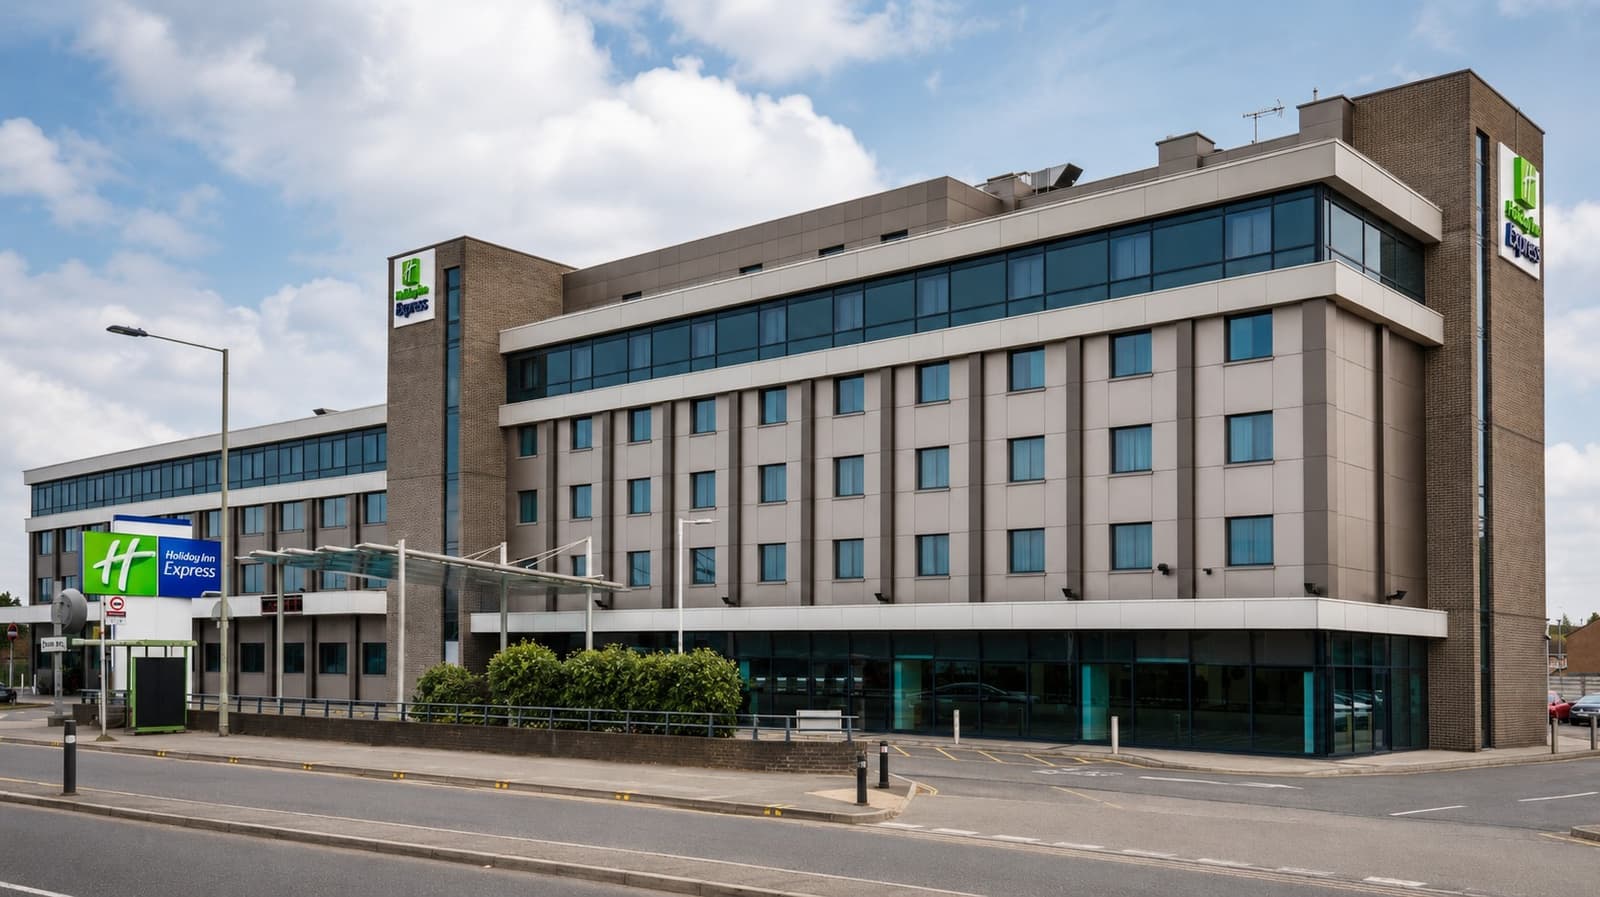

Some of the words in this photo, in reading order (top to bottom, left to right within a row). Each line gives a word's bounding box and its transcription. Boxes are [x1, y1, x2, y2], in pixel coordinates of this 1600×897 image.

[1505, 222, 1540, 264] Express
[396, 299, 429, 318] Express
[166, 551, 200, 564] Holiday
[201, 553, 216, 563] Inn
[164, 561, 215, 579] Express
